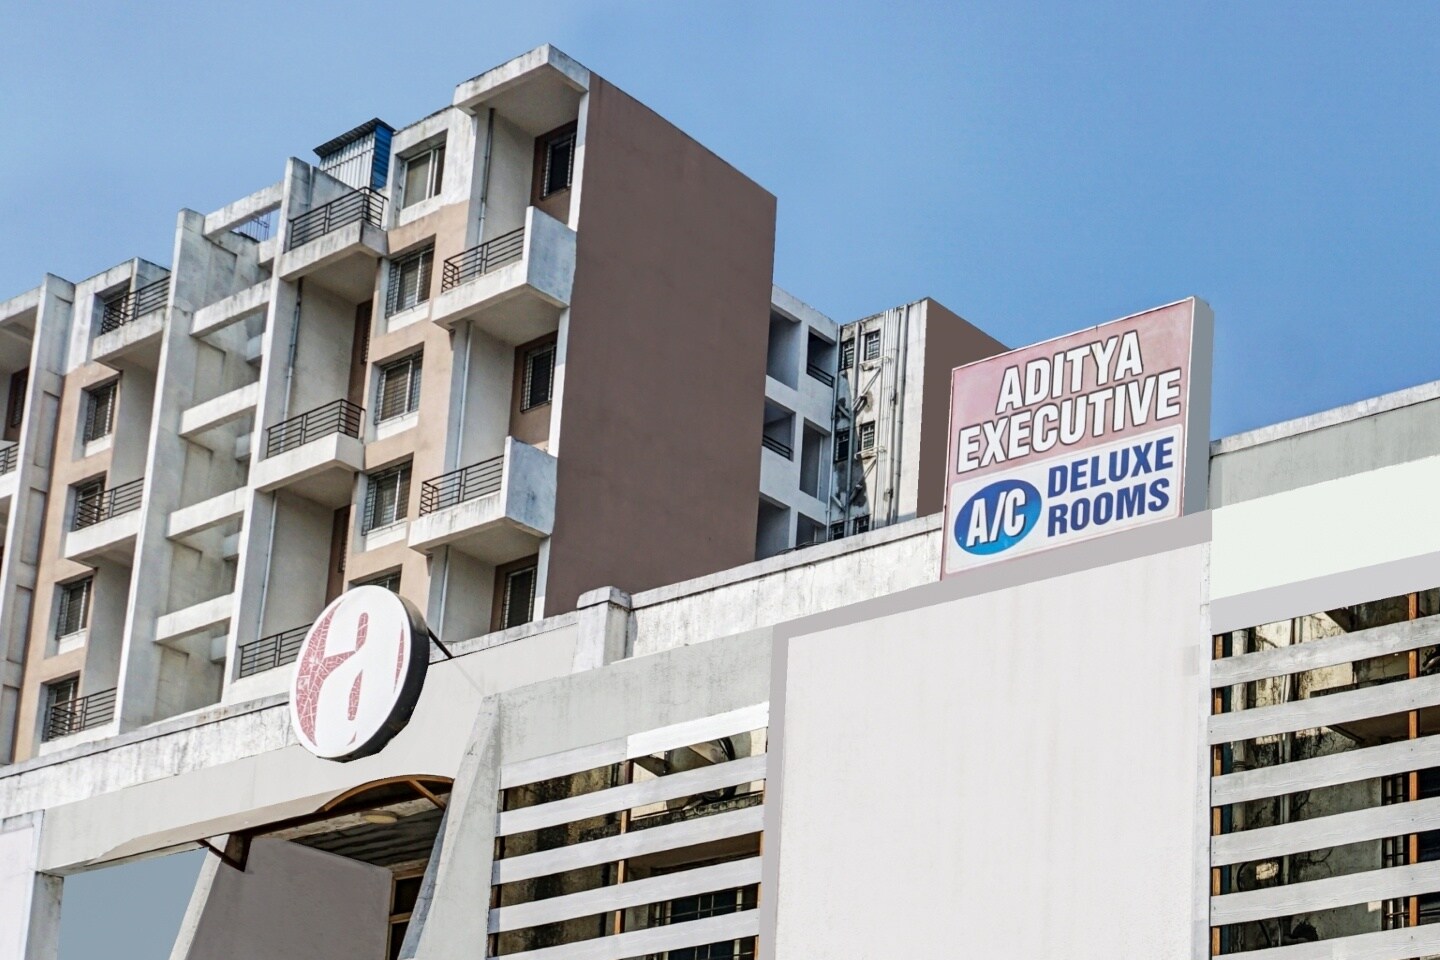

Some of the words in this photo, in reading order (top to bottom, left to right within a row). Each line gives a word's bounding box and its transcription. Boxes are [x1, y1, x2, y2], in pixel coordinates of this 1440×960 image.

[996, 330, 1143, 414] ADITYA
[957, 368, 1182, 474] EXECUTIVE
[1047, 437, 1174, 498] DELUXE
[966, 488, 1026, 548] A/C
[1048, 479, 1169, 538] ROOMS
